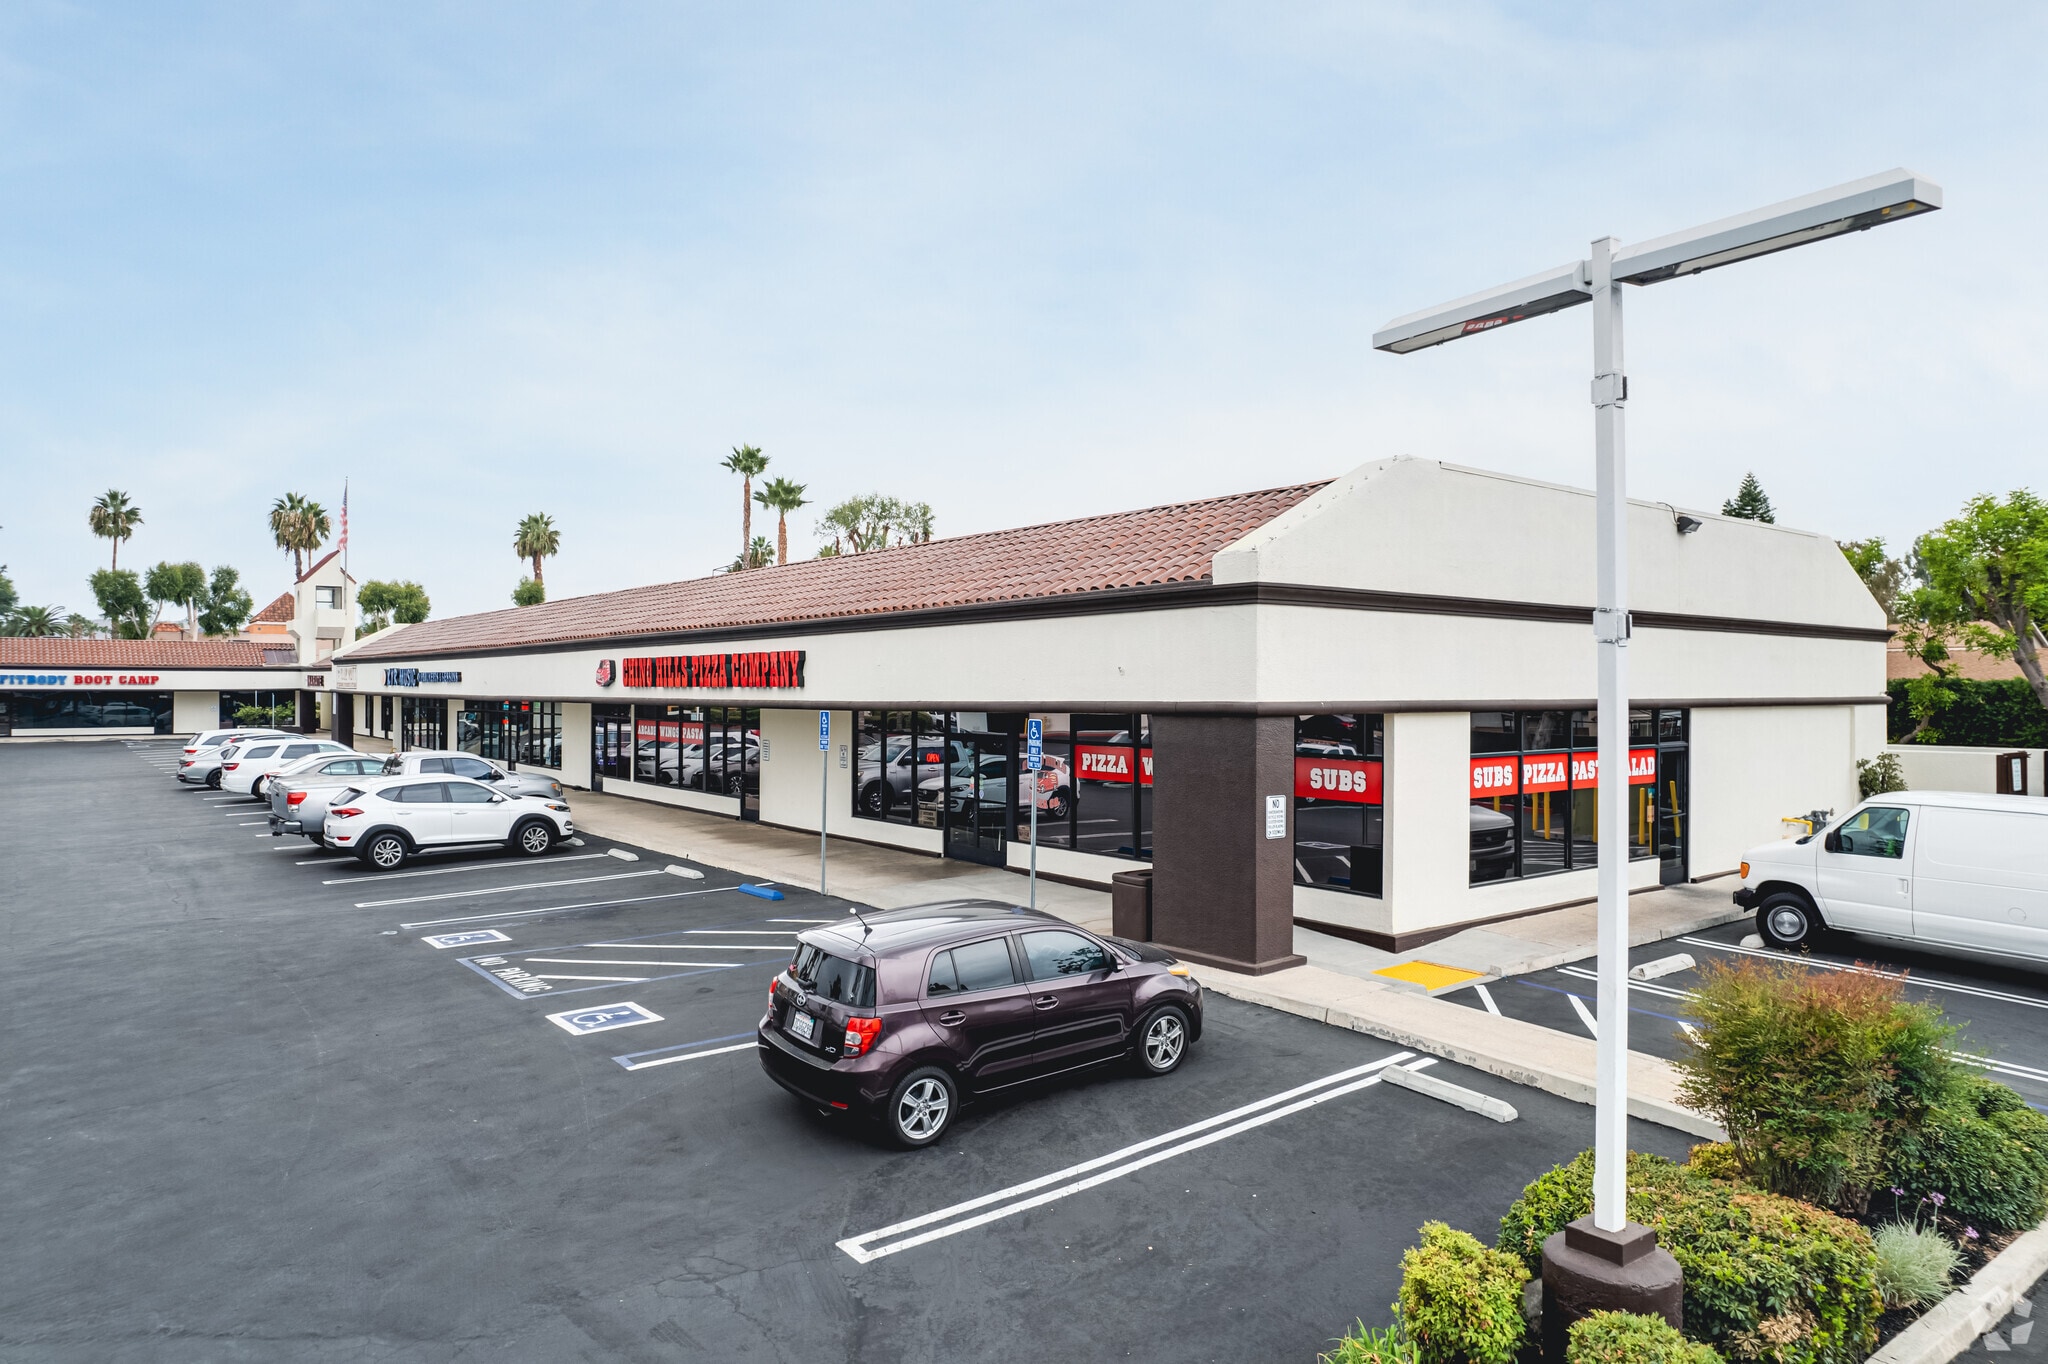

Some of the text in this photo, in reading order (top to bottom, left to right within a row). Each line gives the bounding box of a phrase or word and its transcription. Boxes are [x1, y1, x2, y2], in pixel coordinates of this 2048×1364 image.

[623, 658, 652, 687] CHINO
[655, 656, 688, 687] HILLS
[691, 654, 727, 687] PIZZA
[731, 651, 801, 687] COMPANY
[74, 676, 113, 685] BOOT
[119, 676, 159, 685] CAMP
[659, 726, 679, 738] WINGS
[682, 728, 704, 740] PASTA
[926, 753, 940, 763] OPEN
[1081, 753, 1128, 774] PIZZA
[1310, 767, 1367, 793] SUBS
[1473, 765, 1512, 789] SUBS
[1523, 762, 1566, 785] PIZZA
[1272, 799, 1280, 808] NO
[474, 956, 553, 992] NO PARKING
